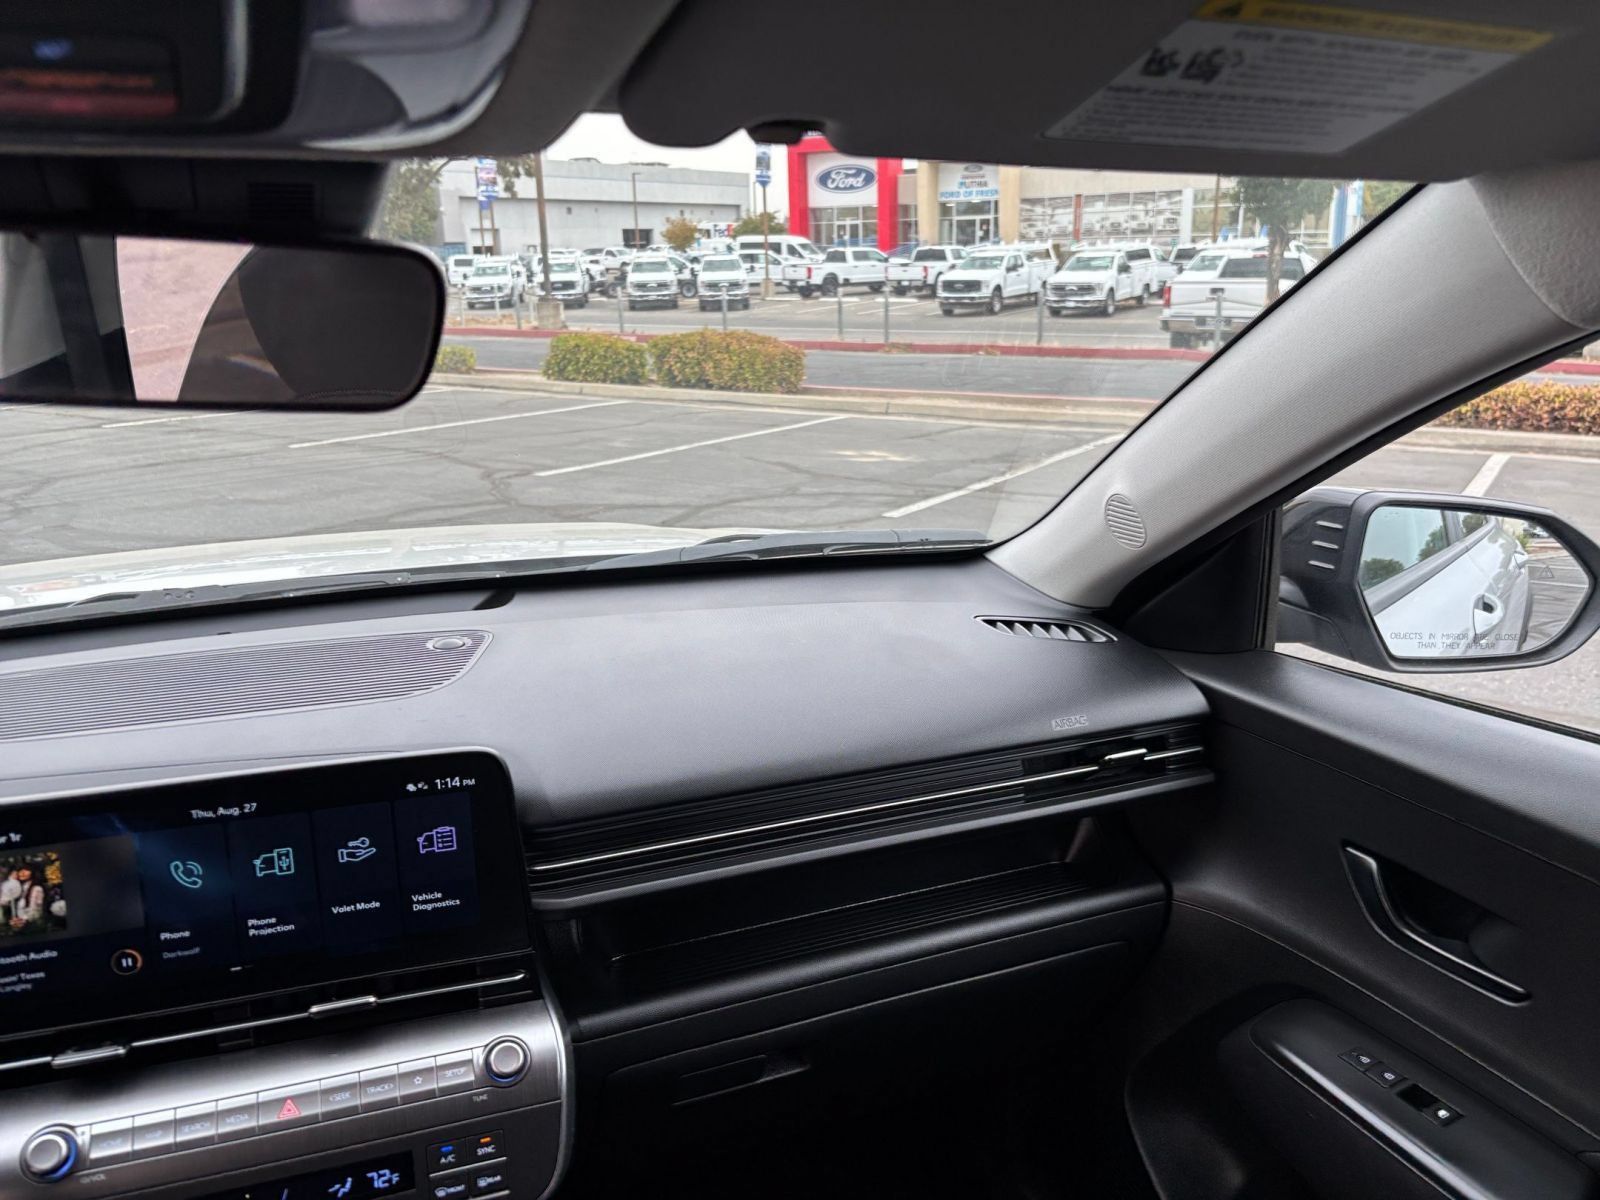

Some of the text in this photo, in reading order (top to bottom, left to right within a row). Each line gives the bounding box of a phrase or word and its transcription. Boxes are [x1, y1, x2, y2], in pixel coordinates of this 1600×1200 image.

[827, 170, 866, 188] Ford
[940, 191, 961, 199] FORD
[963, 190, 974, 198] OF
[1390, 632, 1423, 640] OBJECTS
[1428, 632, 1436, 640] IN
[1441, 632, 1469, 641] MIRROR
[1441, 642, 1460, 650] THEY
[1466, 642, 1496, 650] APPEAR
[1054, 715, 1087, 729] AIRBAG
[435, 777, 460, 789] 1:14
[190, 802, 257, 819] Thu, Aug. 27
[412, 891, 442, 902] Vehicle
[332, 901, 380, 914] Valet Mode
[413, 899, 460, 911] Diagnostics
[248, 917, 277, 927] Phone
[160, 930, 191, 941] Phone
[249, 923, 295, 937] Projection
[29, 949, 58, 960] Audio
[477, 1145, 497, 1156] SYNC
[440, 1154, 456, 1164] A/C
